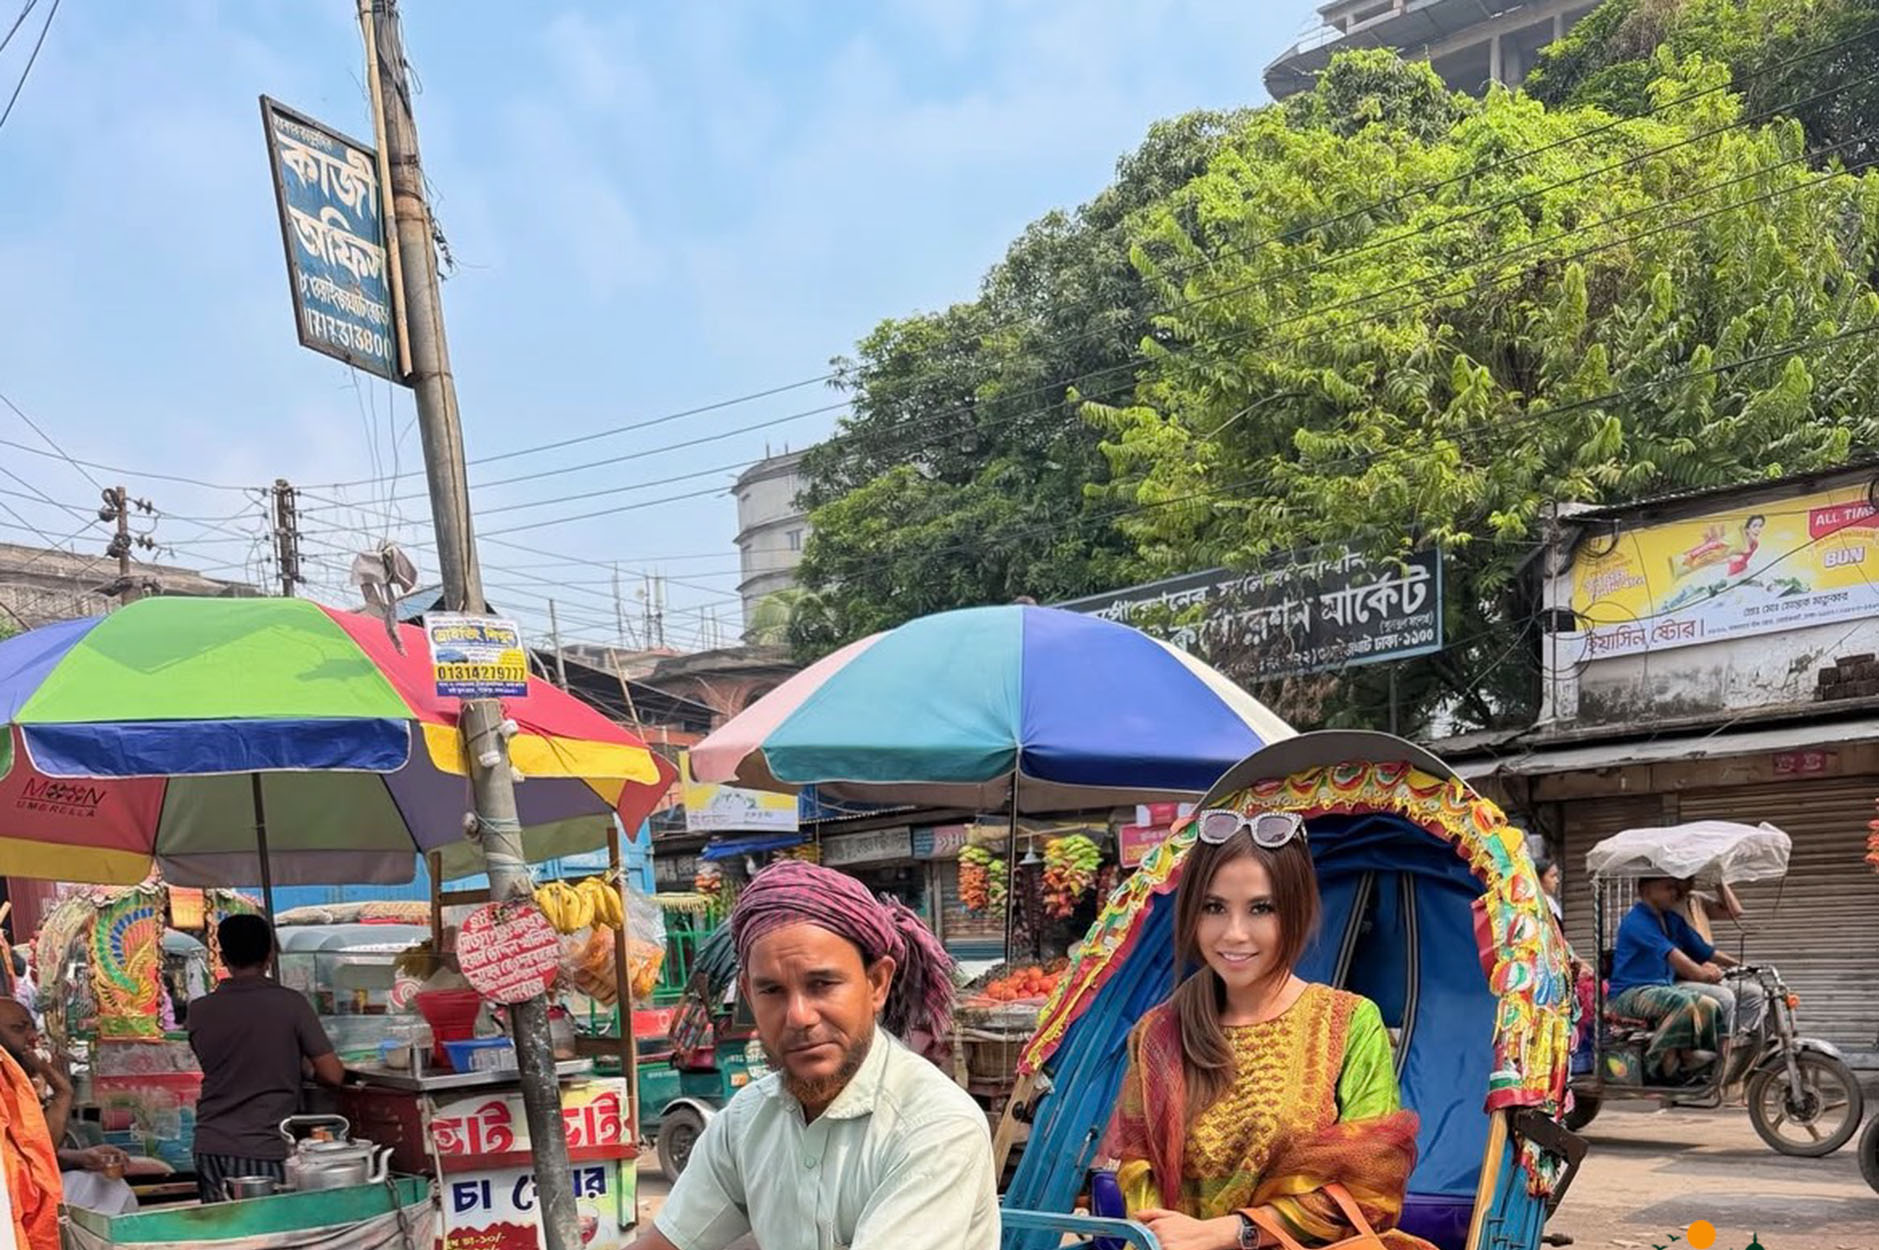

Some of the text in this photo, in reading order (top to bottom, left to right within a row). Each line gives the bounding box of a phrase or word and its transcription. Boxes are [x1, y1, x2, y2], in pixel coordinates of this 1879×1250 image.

[275, 130, 378, 220] কাজী
[287, 203, 389, 291] অফিস
[1815, 512, 1840, 527] ALL
[1824, 545, 1866, 568] BUN
[1320, 564, 1431, 628] মার্কেট
[1588, 625, 1645, 655] ইয়াসিন
[437, 665, 525, 680] 01314279777
[430, 1100, 514, 1154] ভাই
[452, 1179, 491, 1213] চা
